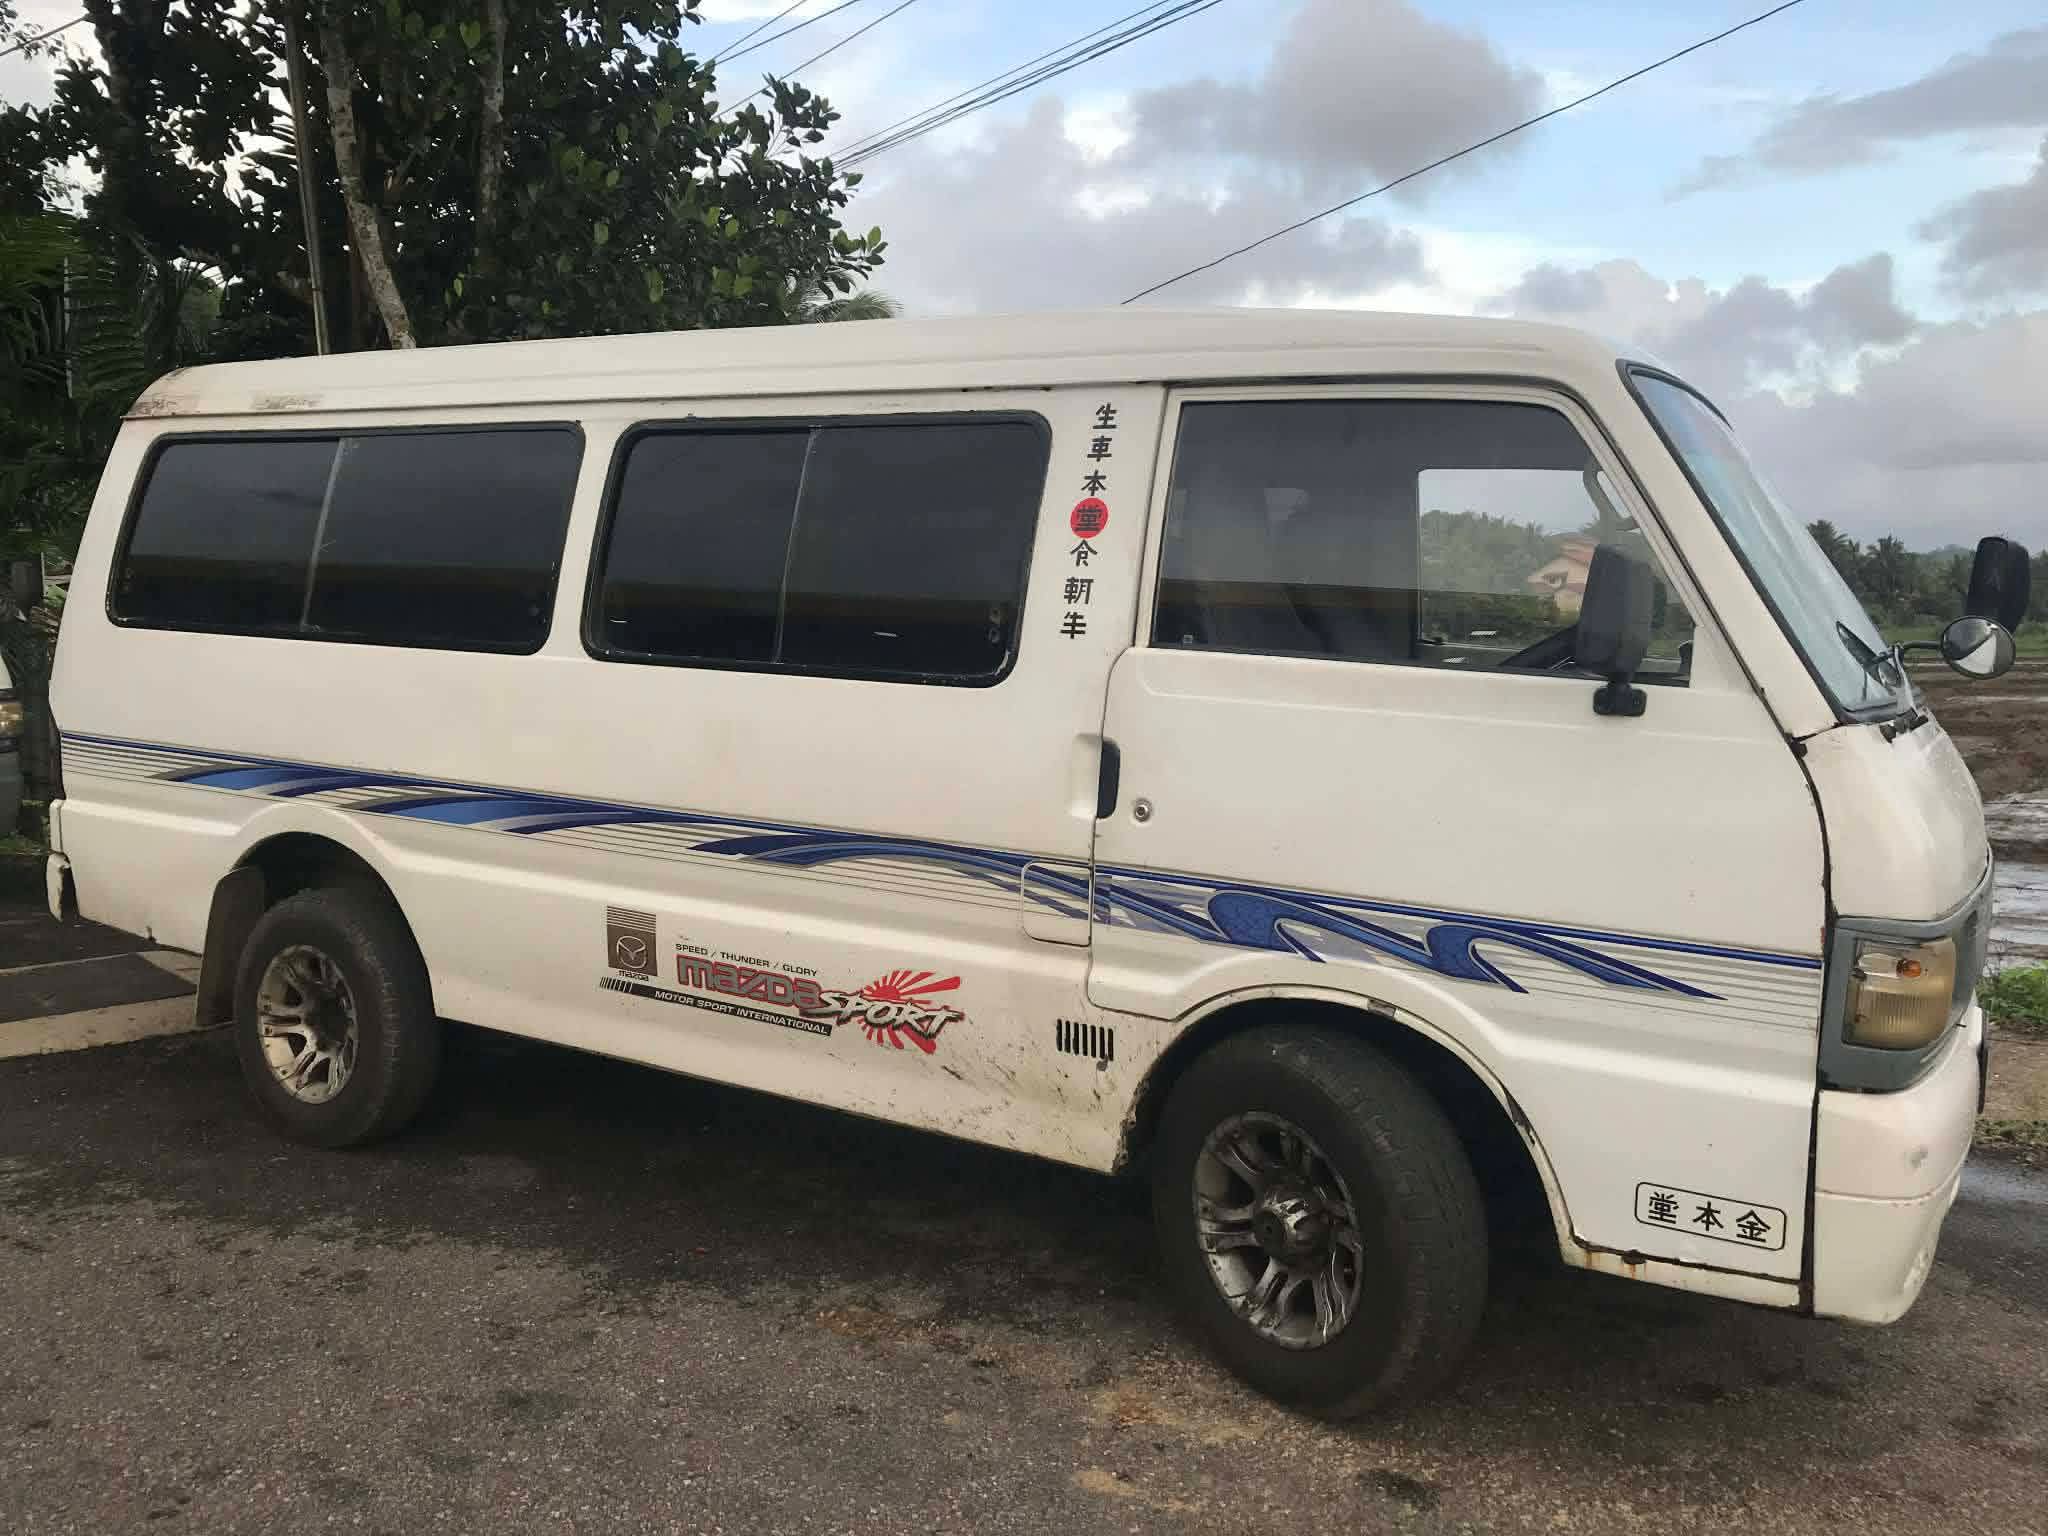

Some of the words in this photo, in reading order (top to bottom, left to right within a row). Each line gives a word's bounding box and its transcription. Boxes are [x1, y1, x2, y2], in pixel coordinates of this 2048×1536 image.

[675, 943, 708, 955] SPEED
[720, 951, 770, 969] THUNDER
[782, 963, 817, 977] GLORY
[655, 991, 694, 1005] MOTOR
[696, 1000, 735, 1014] SPORT
[736, 1007, 828, 1035] INTERNATIONAL
